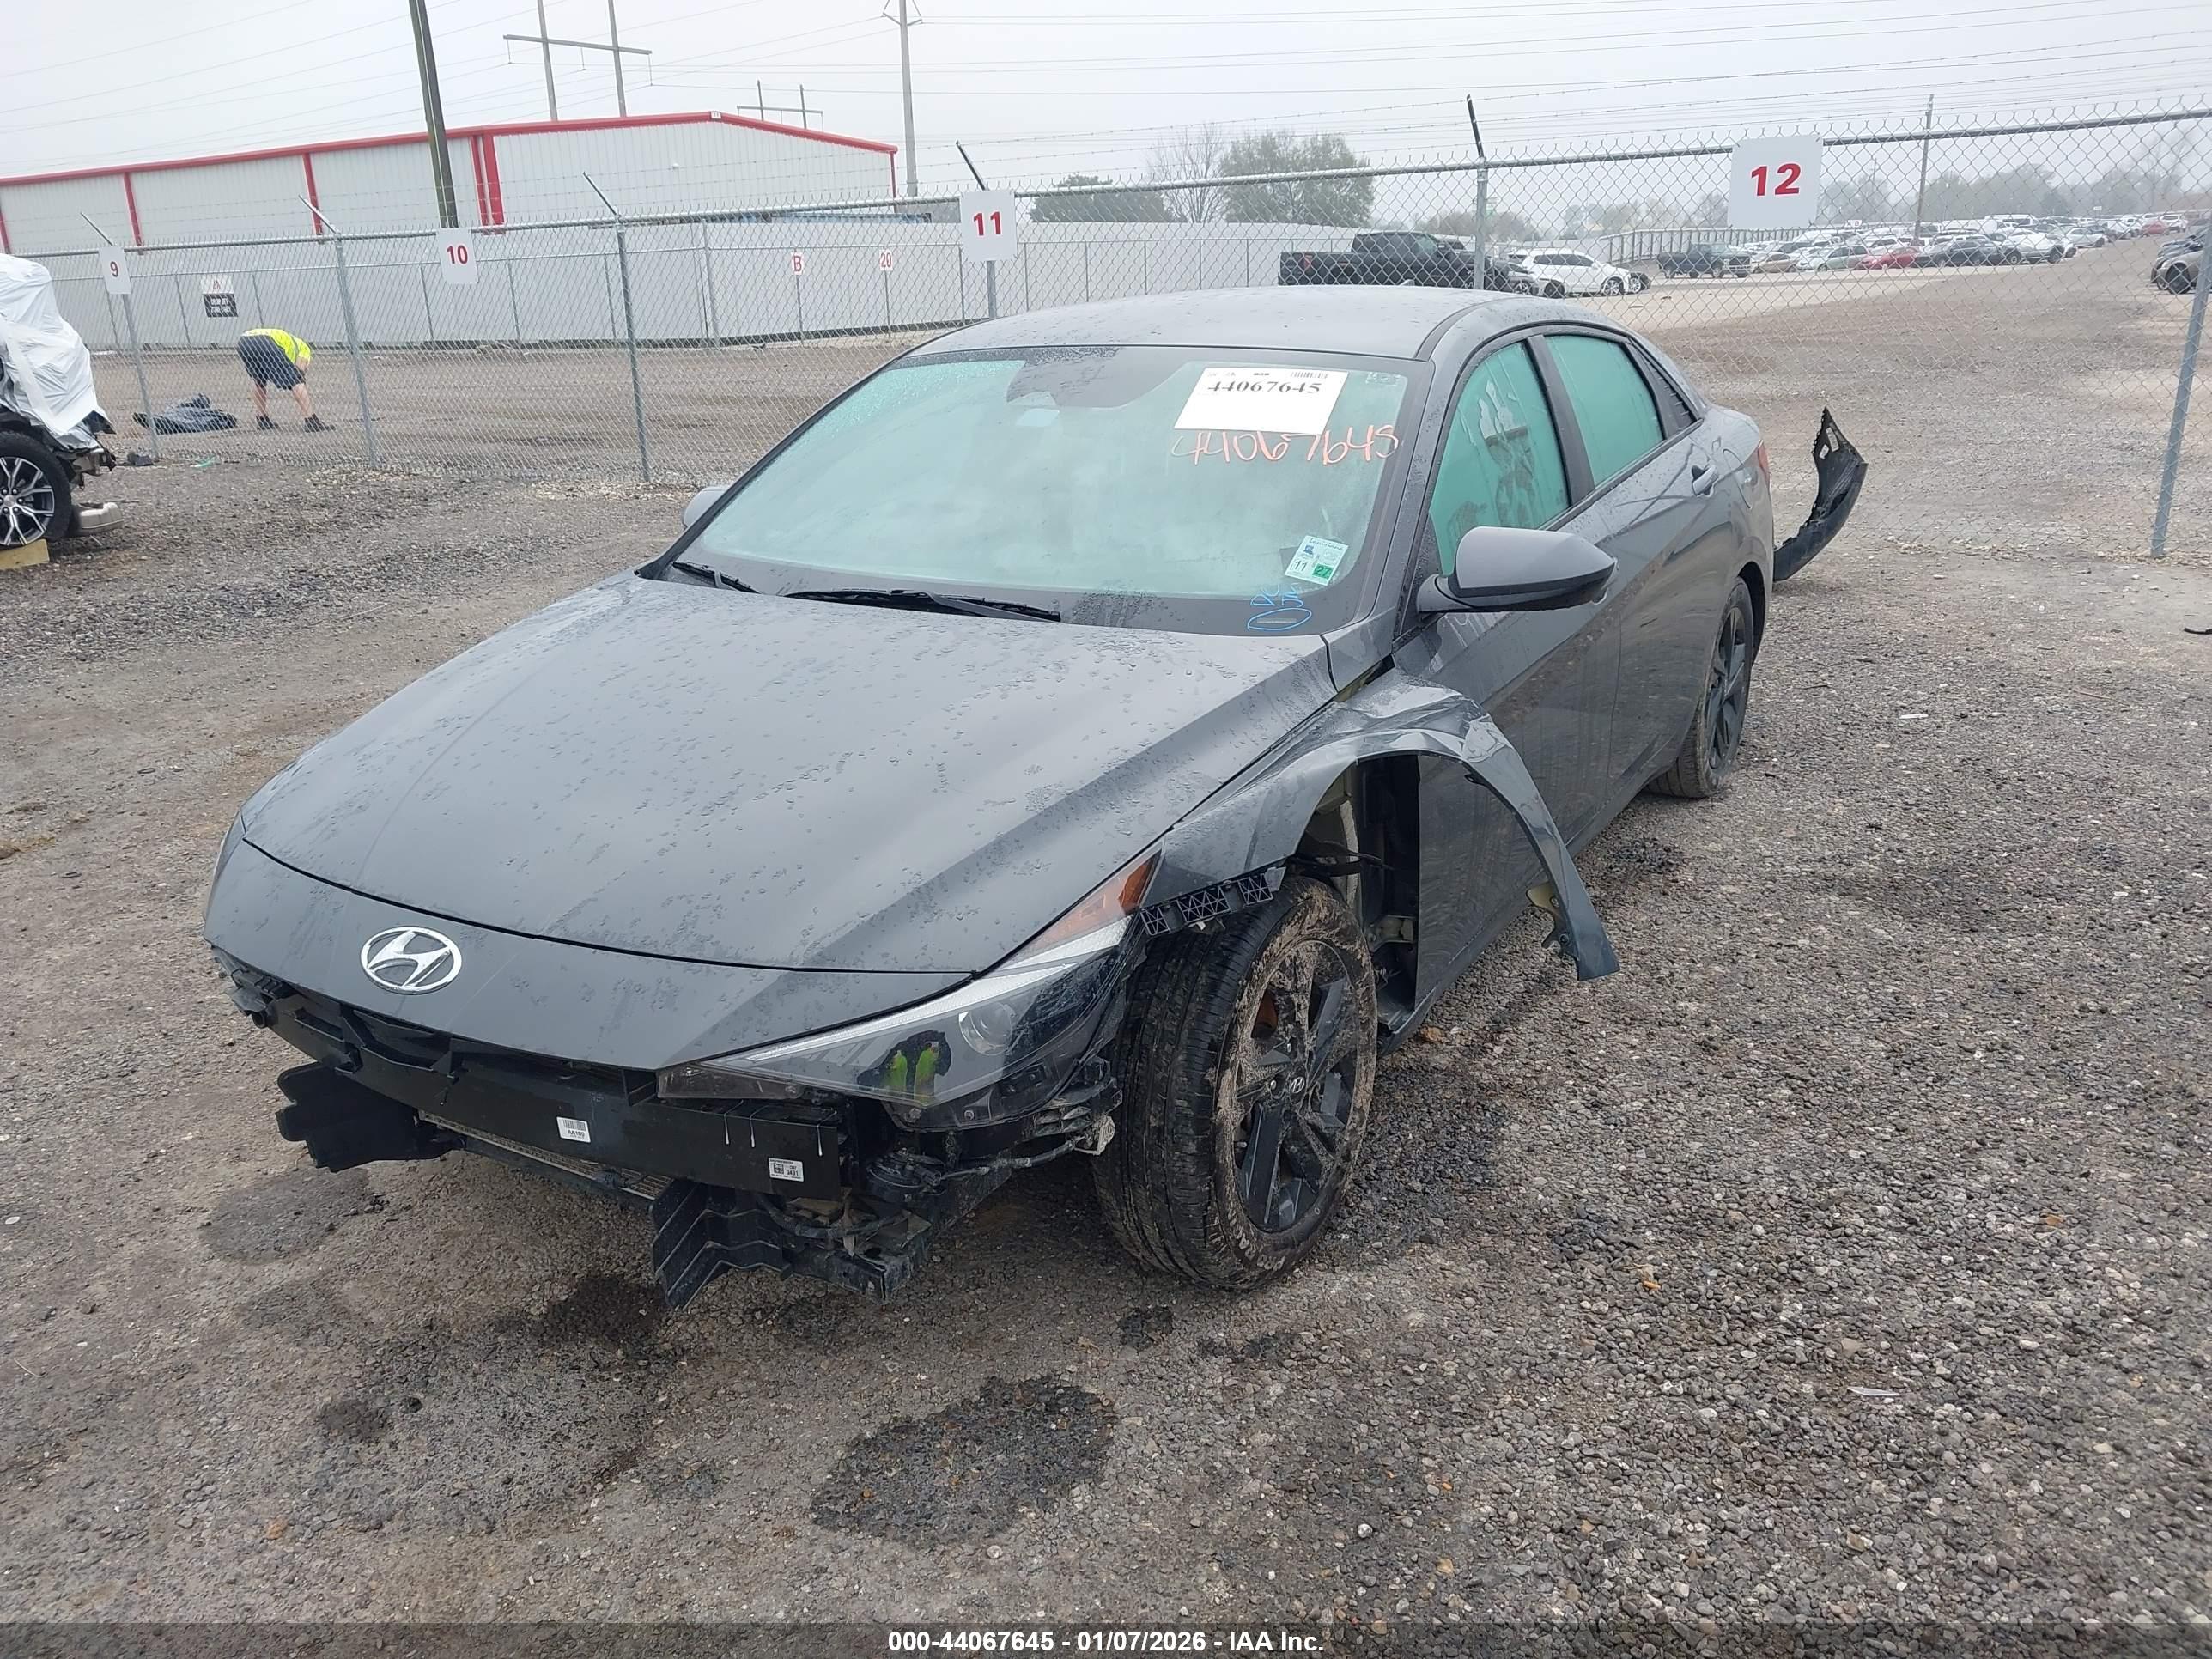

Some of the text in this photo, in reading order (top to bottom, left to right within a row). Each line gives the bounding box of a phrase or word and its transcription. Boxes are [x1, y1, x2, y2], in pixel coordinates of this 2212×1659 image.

[1751, 163, 1801, 197] 12
[973, 211, 1001, 236] 11
[447, 245, 468, 264] 10
[793, 255, 802, 272] B
[880, 252, 892, 268] 20
[110, 260, 118, 278] 9
[1207, 380, 1322, 394] 44067645
[1170, 425, 1399, 466] 44067645
[1315, 564, 1333, 579] 27
